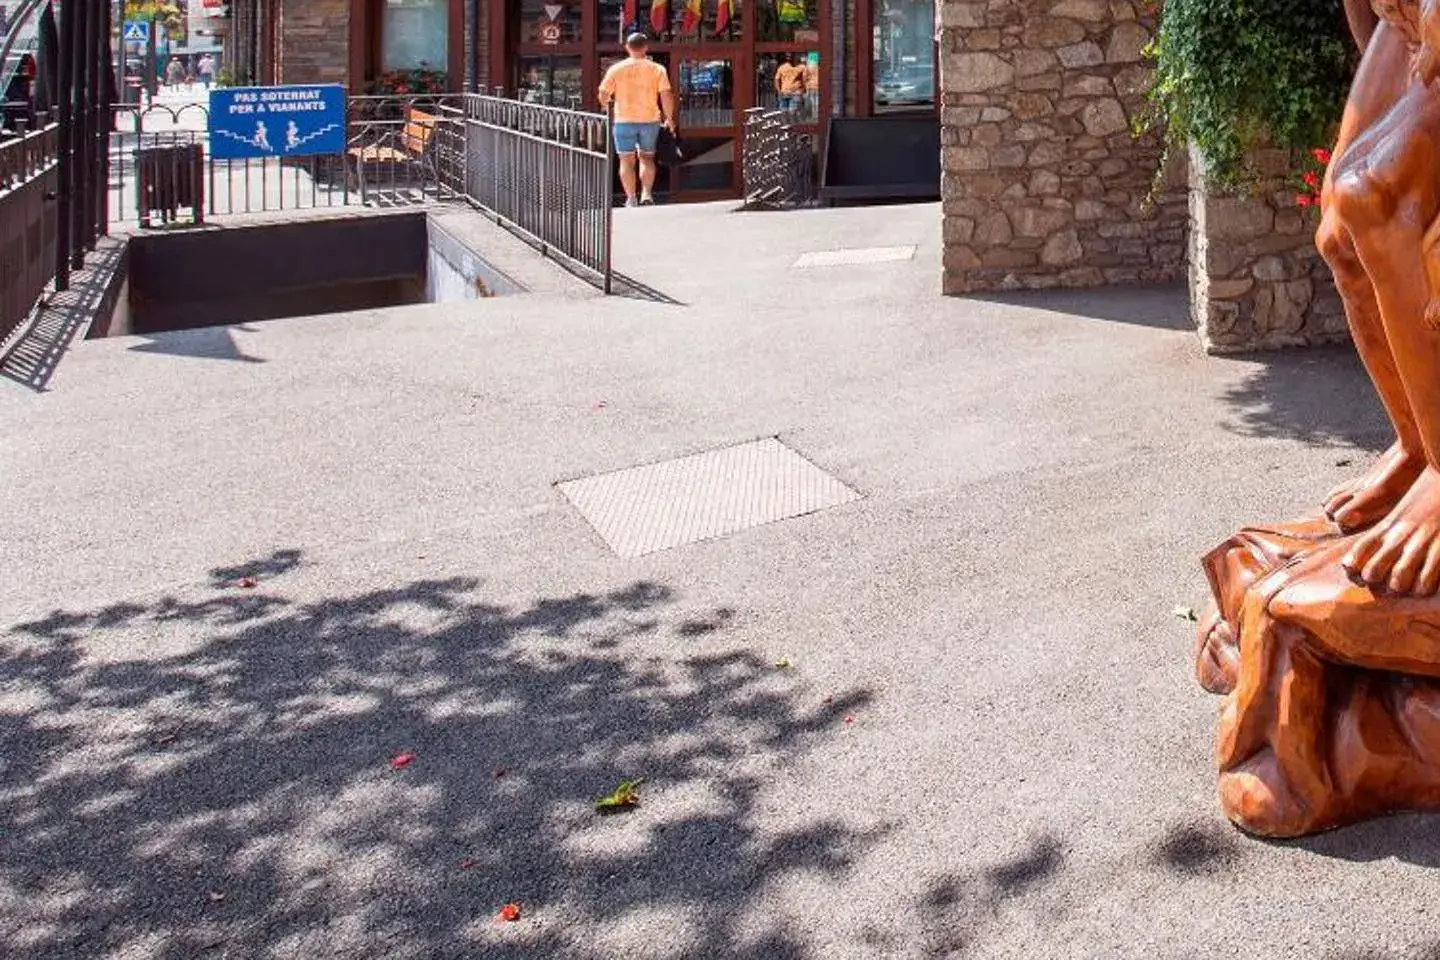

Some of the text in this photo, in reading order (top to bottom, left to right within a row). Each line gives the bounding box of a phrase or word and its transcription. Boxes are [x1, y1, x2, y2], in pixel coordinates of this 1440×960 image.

[234, 90, 322, 103] PAS SOTERRAT
[229, 101, 326, 115] PER A VIANANTS
